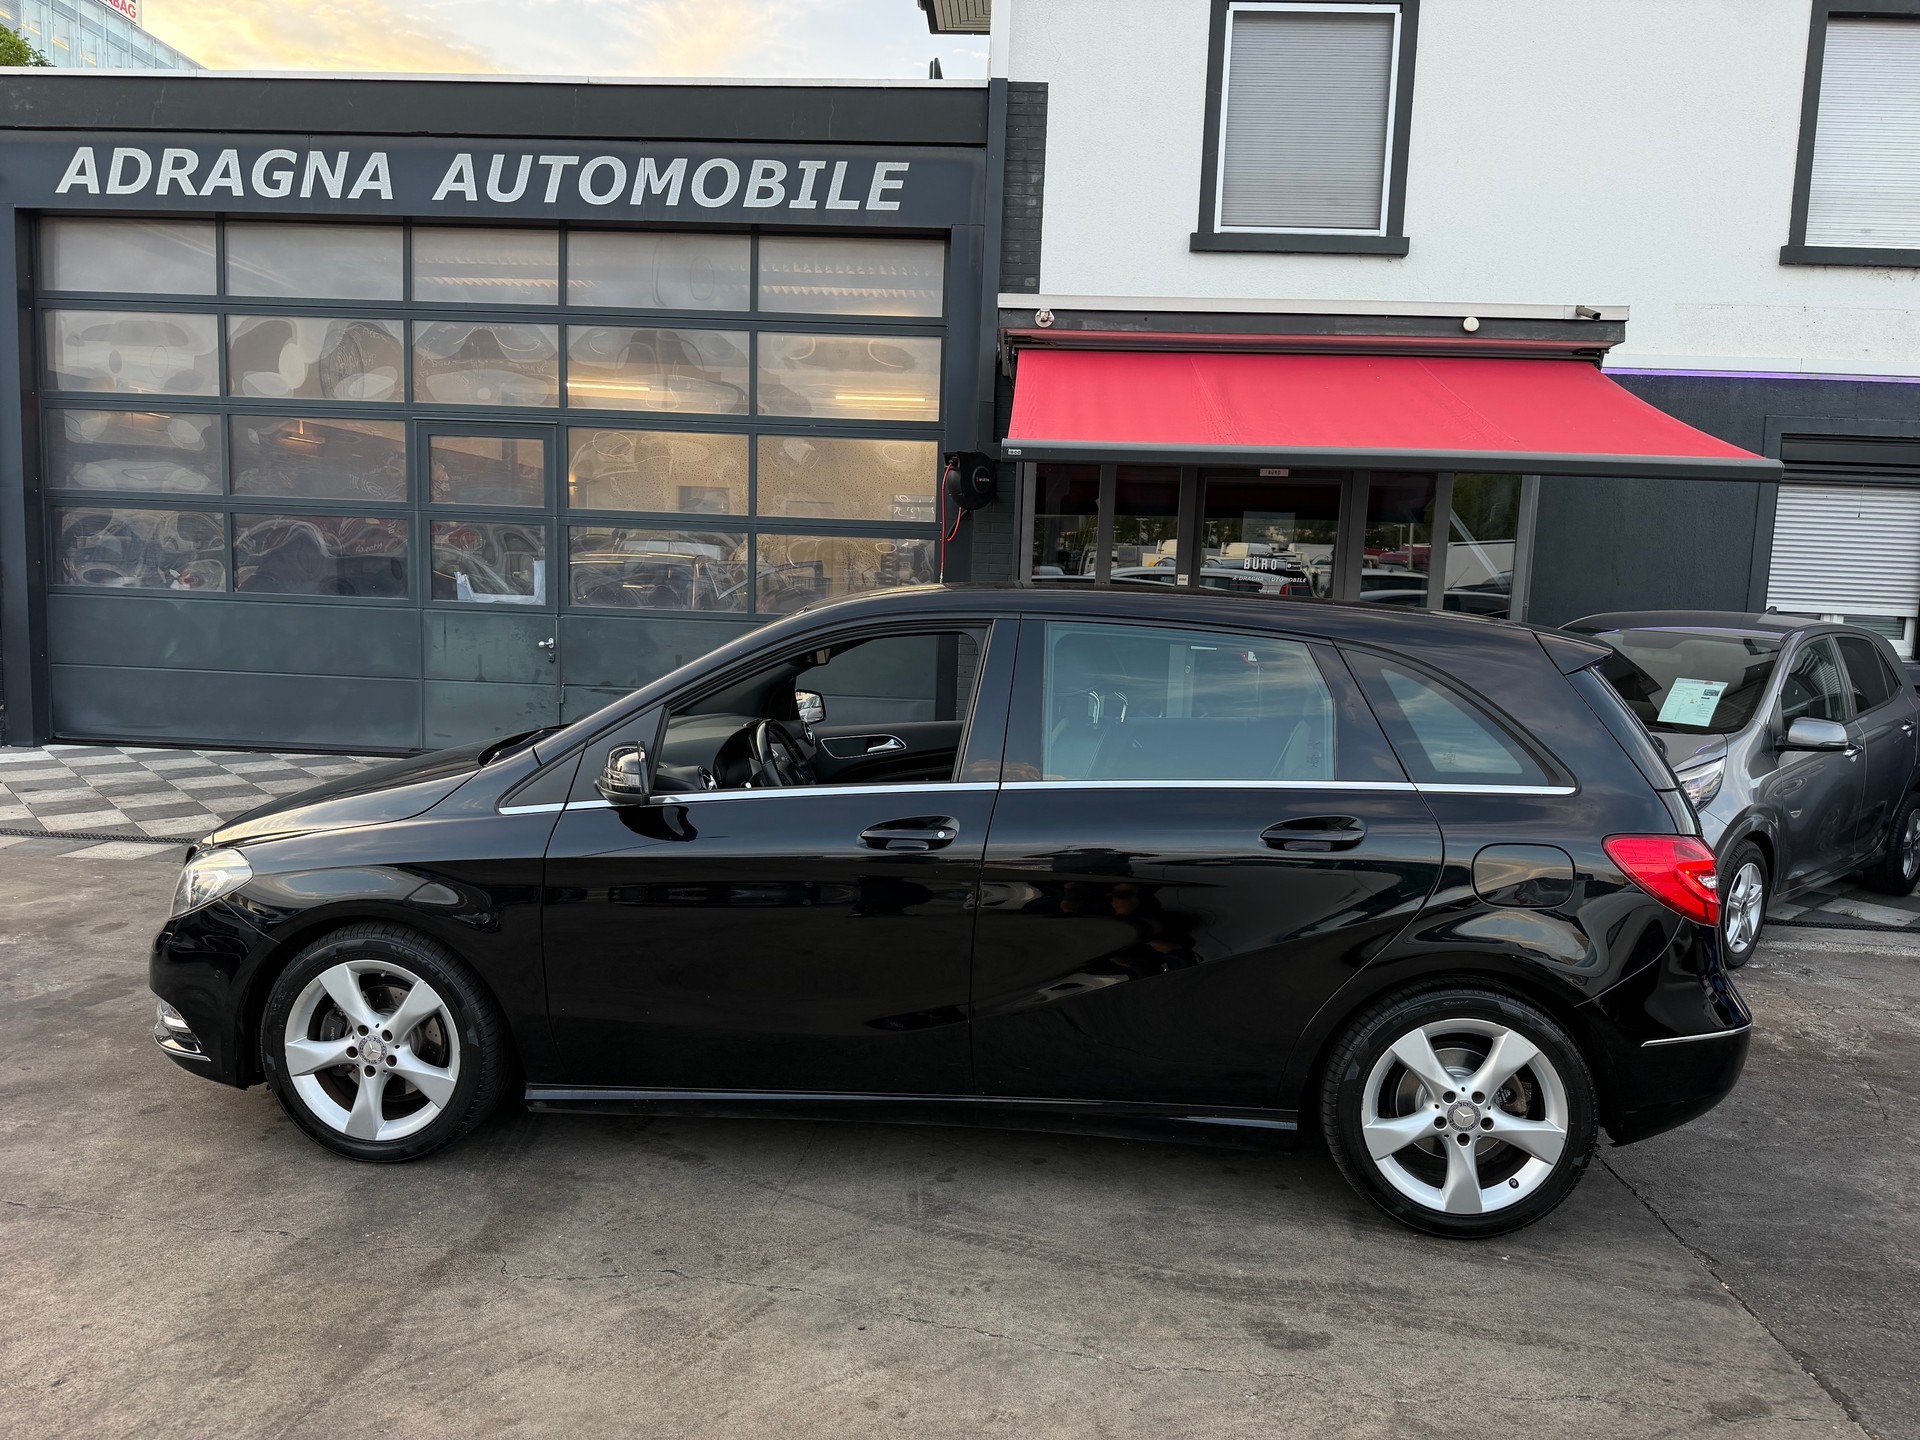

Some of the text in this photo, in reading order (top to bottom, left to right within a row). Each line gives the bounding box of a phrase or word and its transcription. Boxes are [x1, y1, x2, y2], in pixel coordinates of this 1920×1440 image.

[55, 146, 910, 211] ADRAGNA AUTOMOBILE
[1243, 556, 1277, 571] BÜRO
